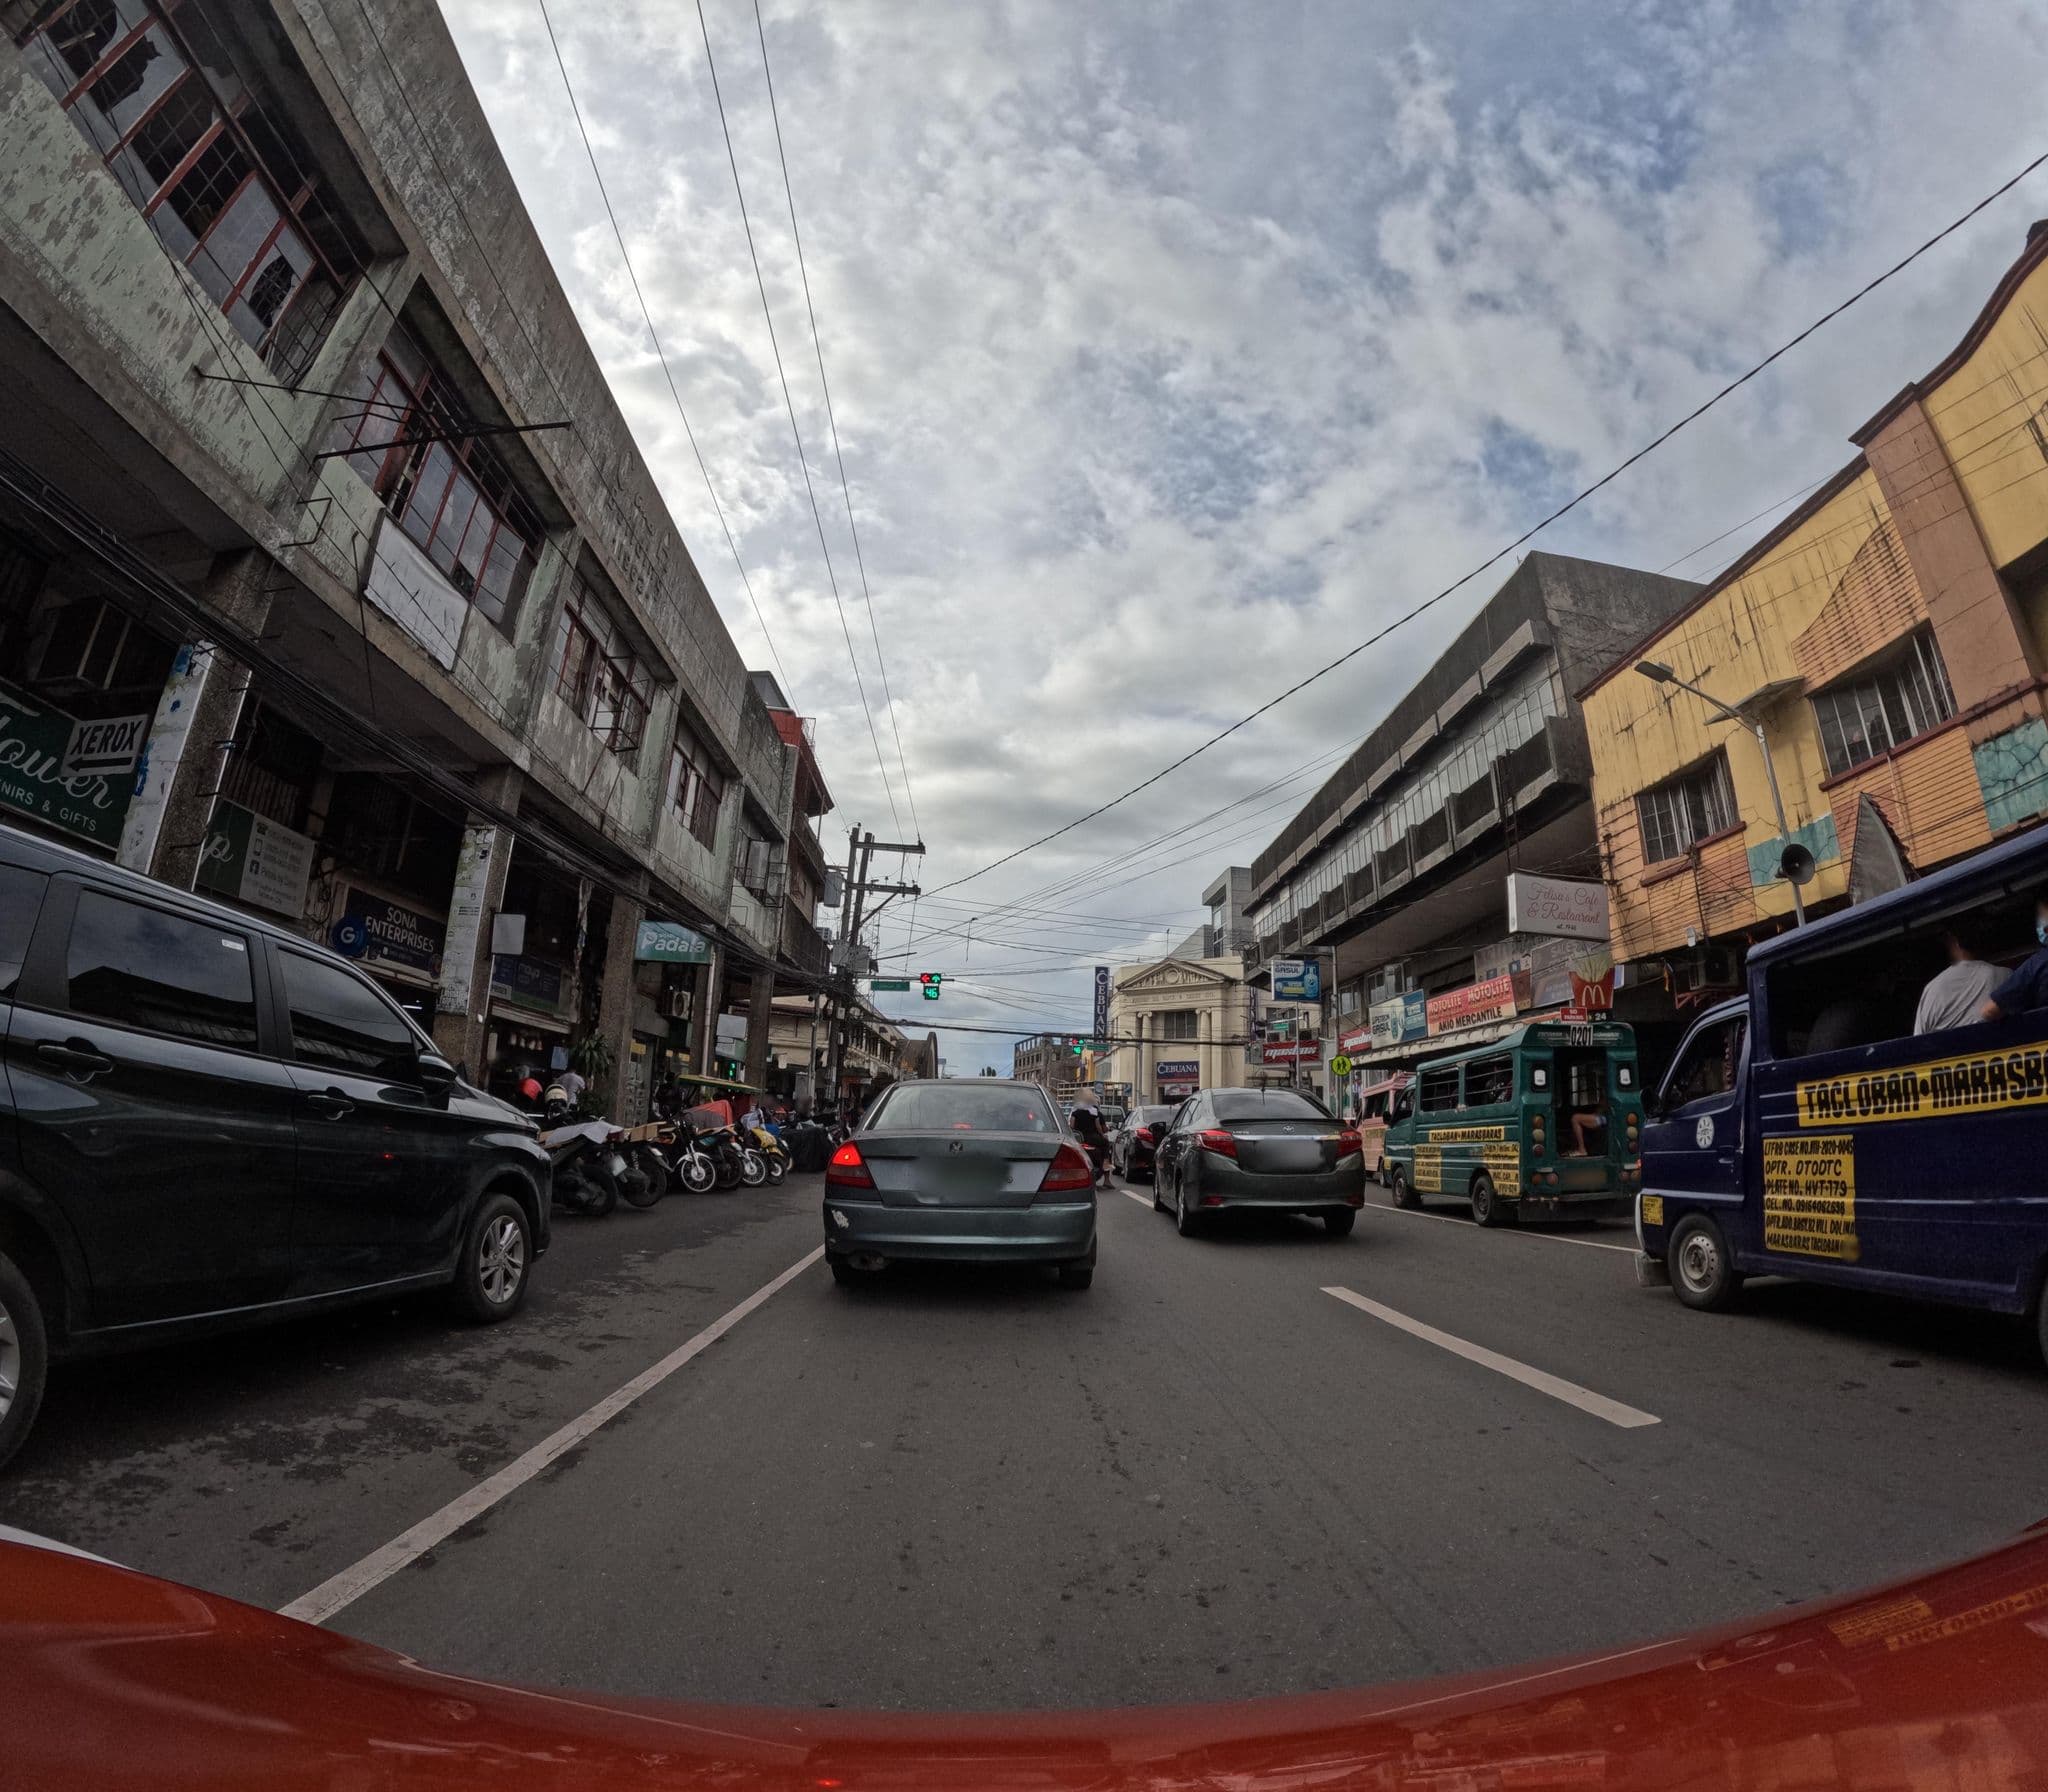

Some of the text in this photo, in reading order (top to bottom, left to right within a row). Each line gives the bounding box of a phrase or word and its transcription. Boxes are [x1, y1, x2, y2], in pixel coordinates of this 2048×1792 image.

[70, 720, 142, 756] XEROX
[42, 800, 50, 813] &
[60, 807, 97, 832] GIFTS
[386, 906, 417, 930] SONA
[1527, 901, 1600, 924] & Restaurant
[366, 916, 434, 953] ENTERPRISES
[641, 931, 706, 952] Padala
[925, 987, 938, 998] 46
[1467, 978, 1511, 1002] MOTOLITE
[1456, 1006, 1502, 1027] MERCANTILE
[1571, 1025, 1592, 1047] 0201
[1158, 1063, 1198, 1074] CEBUANA
[1766, 1179, 1787, 1195] PLATE
[1789, 1180, 1803, 1195] NO.
